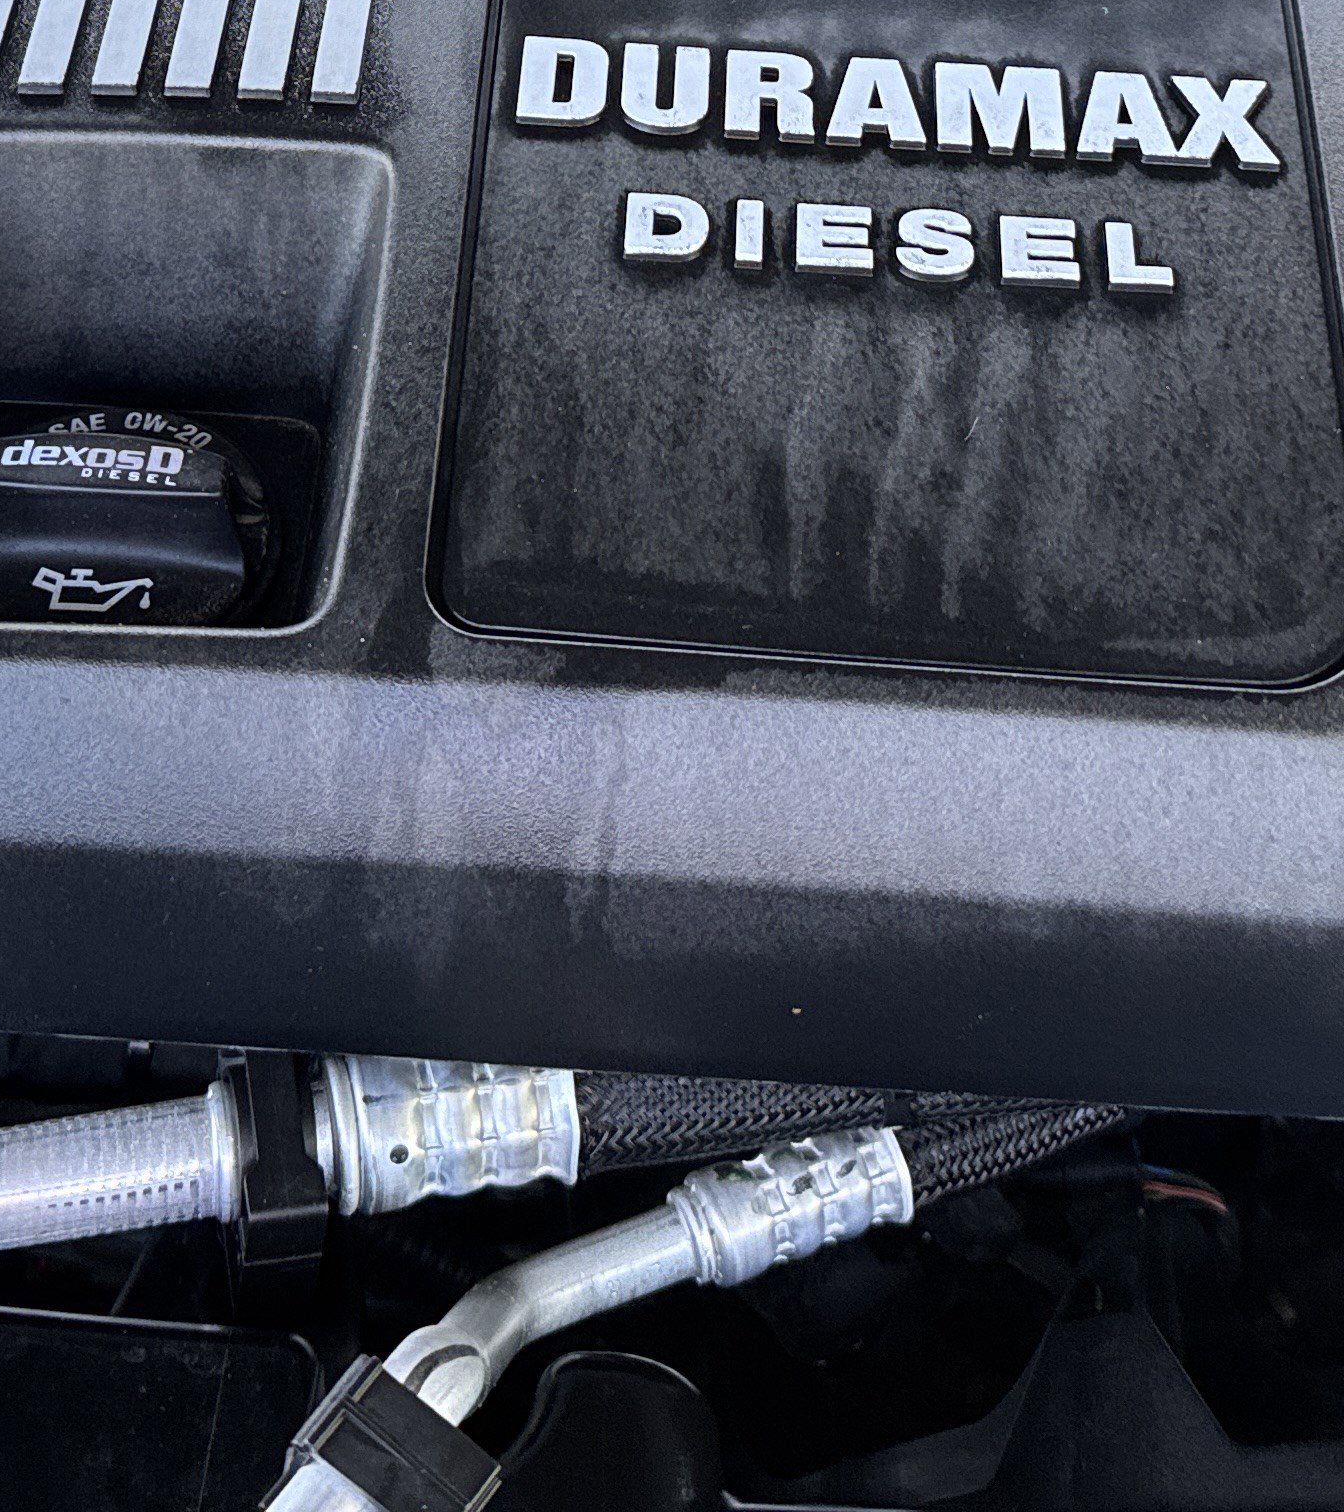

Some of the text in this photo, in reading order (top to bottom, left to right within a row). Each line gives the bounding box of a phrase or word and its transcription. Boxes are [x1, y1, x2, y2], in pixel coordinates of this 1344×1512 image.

[515, 35, 1281, 172] DURAMAX
[623, 192, 1175, 292] DIESEL
[1, 439, 185, 475] dexosD
[81, 467, 177, 487] DIESEL
